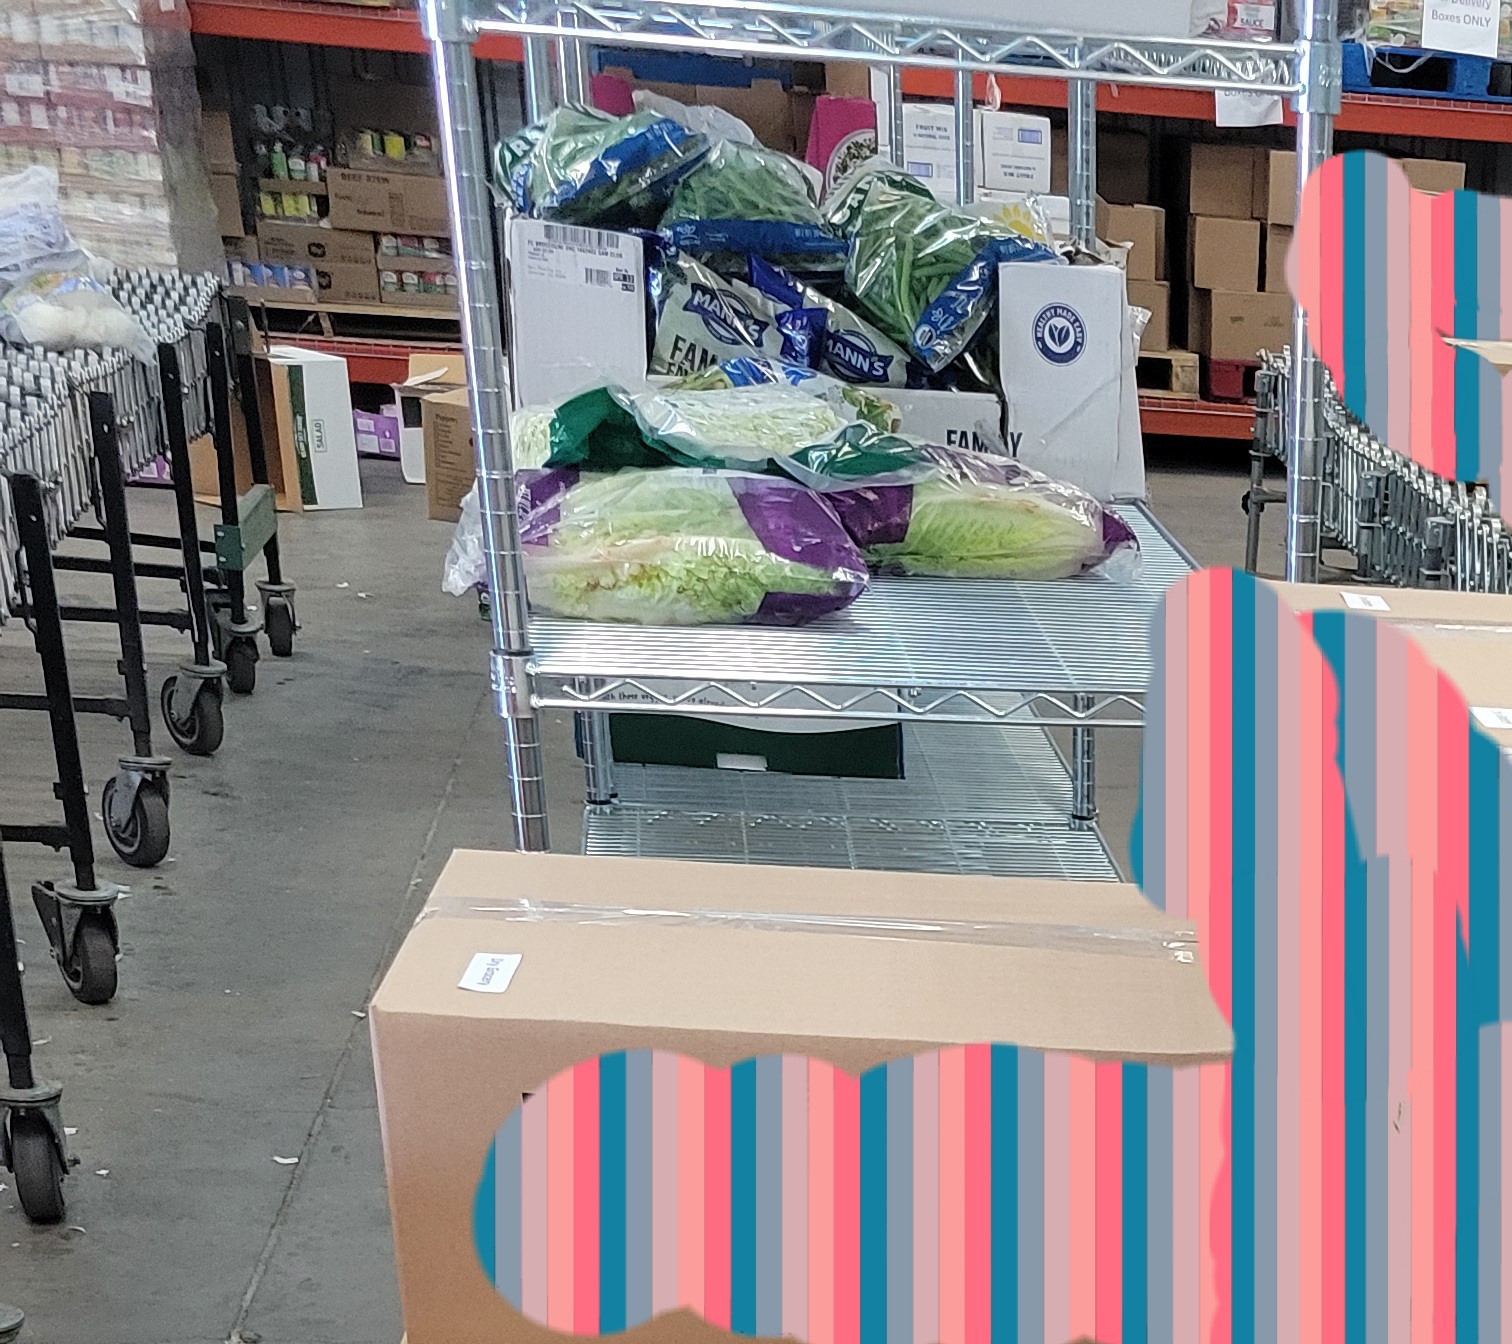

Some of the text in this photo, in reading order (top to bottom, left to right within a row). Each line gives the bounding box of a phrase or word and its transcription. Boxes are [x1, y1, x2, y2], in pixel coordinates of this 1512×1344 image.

[1432, 10, 1491, 28] Boxes ONLY
[1036, 307, 1083, 344] HEALTHY MADE EASY
[316, 422, 325, 450] SALAD
[946, 429, 1024, 458] FAMY
